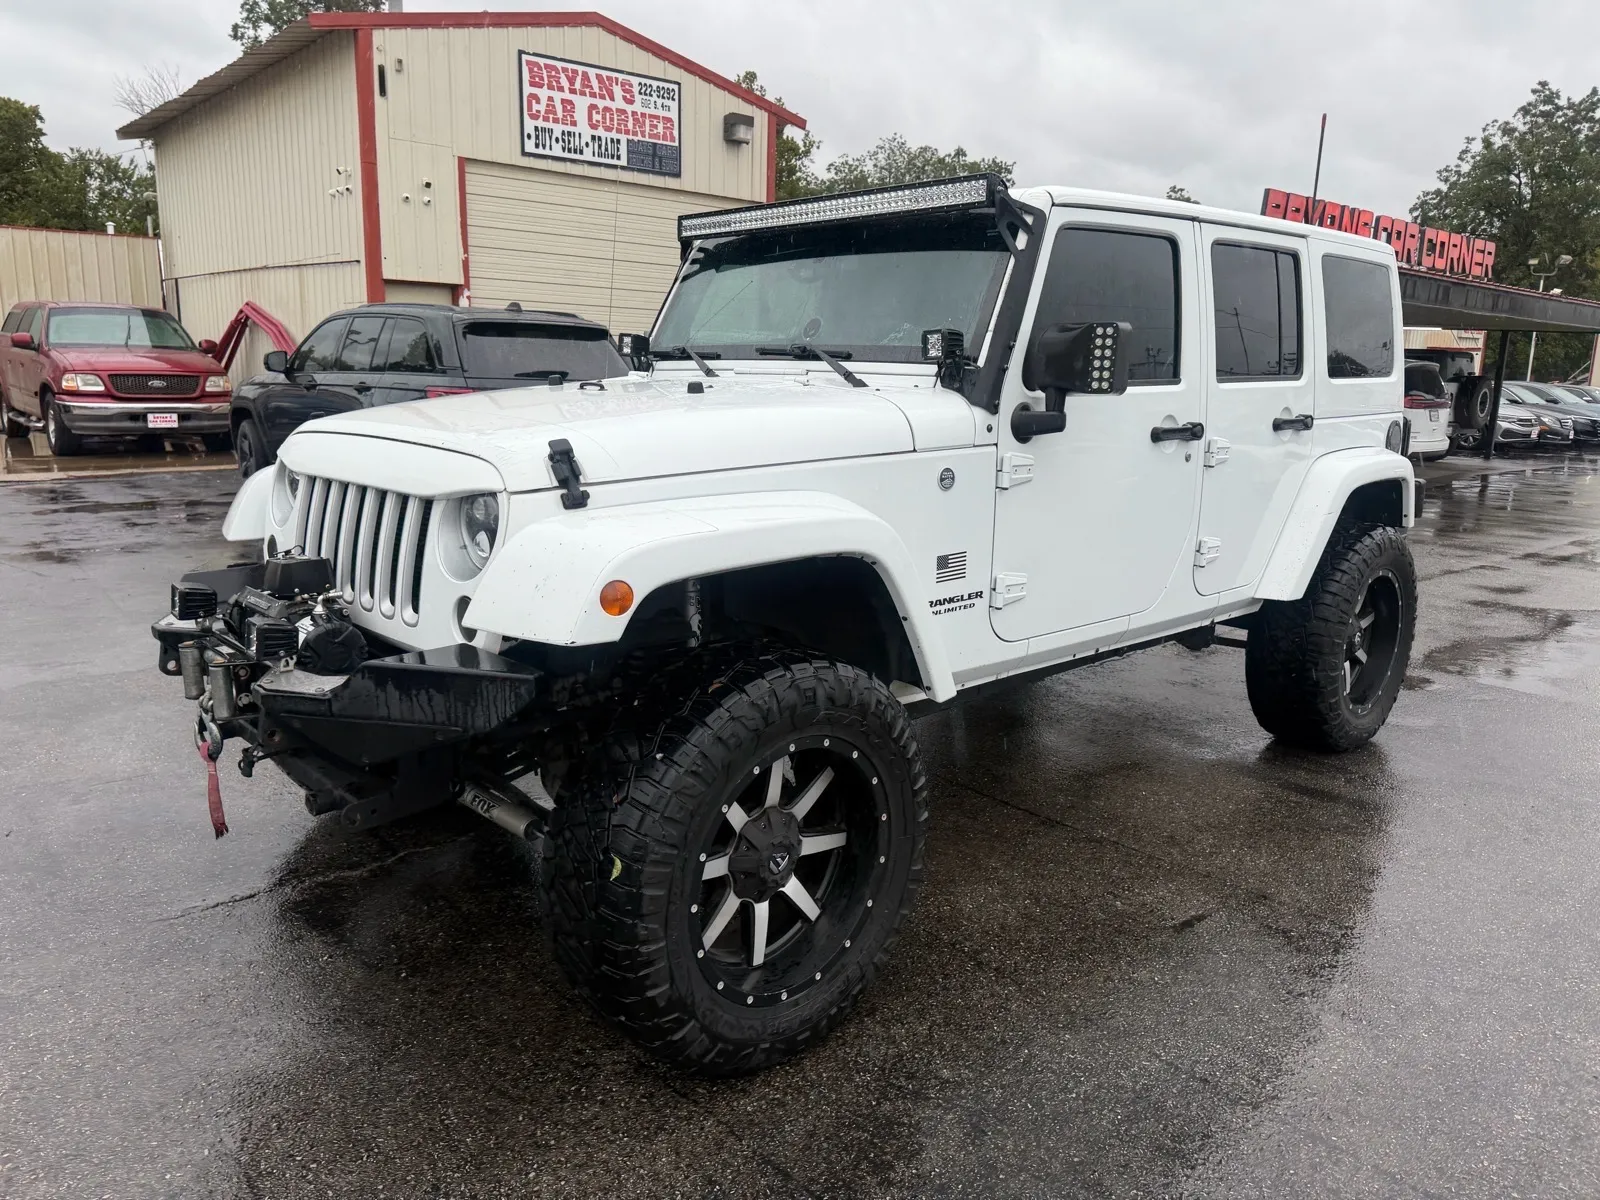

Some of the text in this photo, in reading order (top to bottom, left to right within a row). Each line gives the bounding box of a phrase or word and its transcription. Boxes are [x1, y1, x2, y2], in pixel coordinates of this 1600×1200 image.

[525, 59, 635, 106] BRYAN'S
[638, 81, 676, 102] 222-9292
[527, 92, 676, 143] CAR CORNER
[534, 126, 621, 160] BUY SELL TRADE
[1376, 215, 1419, 265] CAR
[1420, 227, 1496, 279] CORNER
[471, 793, 499, 818] FOX
